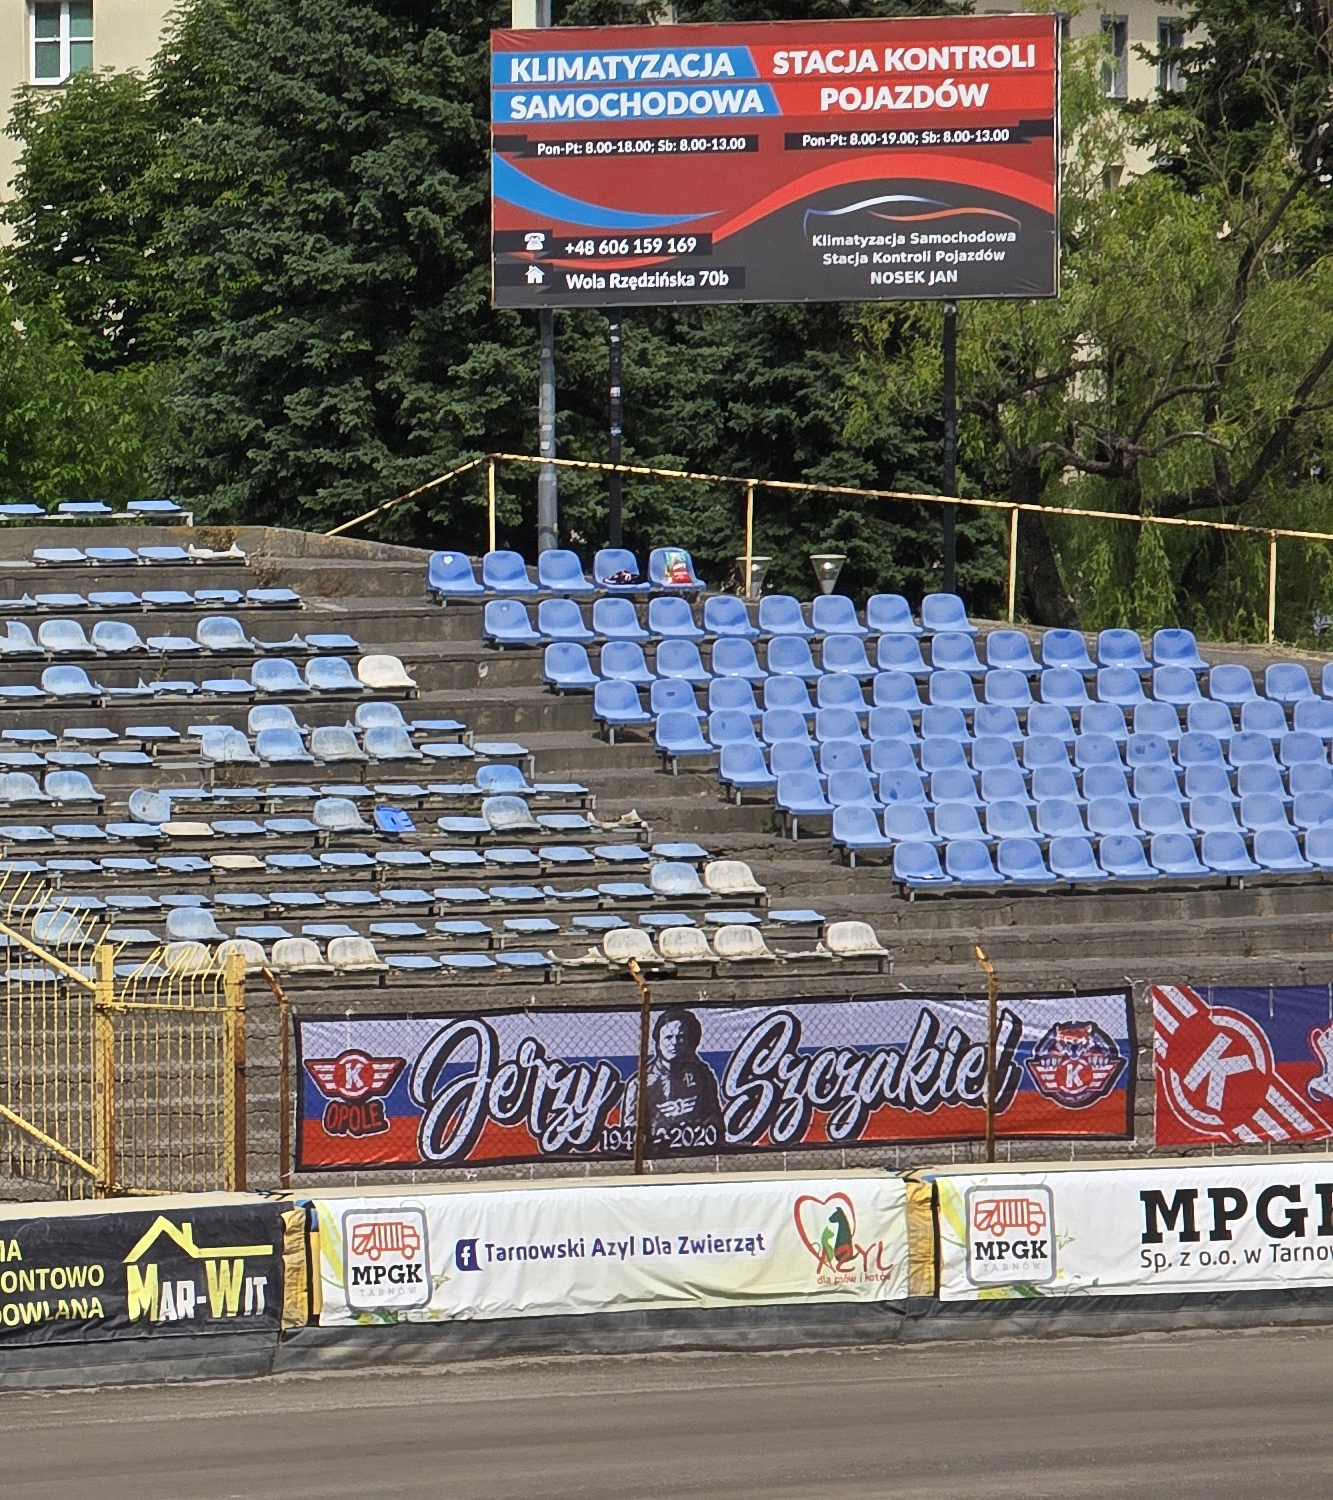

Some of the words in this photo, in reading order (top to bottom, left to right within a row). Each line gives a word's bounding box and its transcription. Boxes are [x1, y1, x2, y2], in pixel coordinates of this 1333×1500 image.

[511, 52, 735, 82] KLIMATYZACJA
[773, 48, 878, 75] STACJA
[885, 44, 1036, 72] KONTROLI
[510, 88, 764, 120] SAMOCHODOWA
[820, 79, 989, 111] POJAZDÓW
[537, 143, 583, 155] Pon-Pt:
[586, 141, 655, 154] 8.00-18.00;
[658, 140, 677, 152] Sb:
[680, 137, 746, 151] 8.00-13.00
[802, 134, 847, 147] Pon-Pt:
[850, 132, 919, 146] 8.00-19.00;
[922, 130, 941, 144] Sb:
[943, 129, 1009, 143] 8.00-13.00
[565, 239, 595, 255] +48
[599, 239, 629, 255] 606
[634, 237, 662, 254] 159
[667, 237, 696, 253] 169
[812, 234, 906, 248] Klimatyzacja
[910, 230, 1016, 244] Samochodowa
[822, 252, 868, 266] Stacja
[873, 250, 931, 264] Kontroli
[935, 248, 1005, 263] Pojazdów
[566, 273, 605, 290] Wola
[610, 271, 695, 291] Rzędzińska
[699, 270, 729, 287] 70b
[870, 271, 925, 285] NOSEK
[929, 269, 958, 286] JAN
[725, 1008, 1018, 1142] Szczakiel
[410, 1018, 620, 1161] Jerzy
[327, 1102, 382, 1131] OPOLE
[485, 1238, 585, 1262] Tarnowski
[591, 1236, 635, 1261] Azyl
[642, 1236, 672, 1256] Dla
[678, 1233, 766, 1256] Zwierząt
[974, 1239, 1048, 1260] MPGK
[1140, 1249, 1173, 1273] Sp.
[1180, 1251, 1191, 1266] z
[1199, 1249, 1237, 1266] o.o.
[1244, 1248, 1262, 1264] w
[1269, 1243, 1333, 1263] Tarno
[352, 1263, 423, 1285] MPGK
